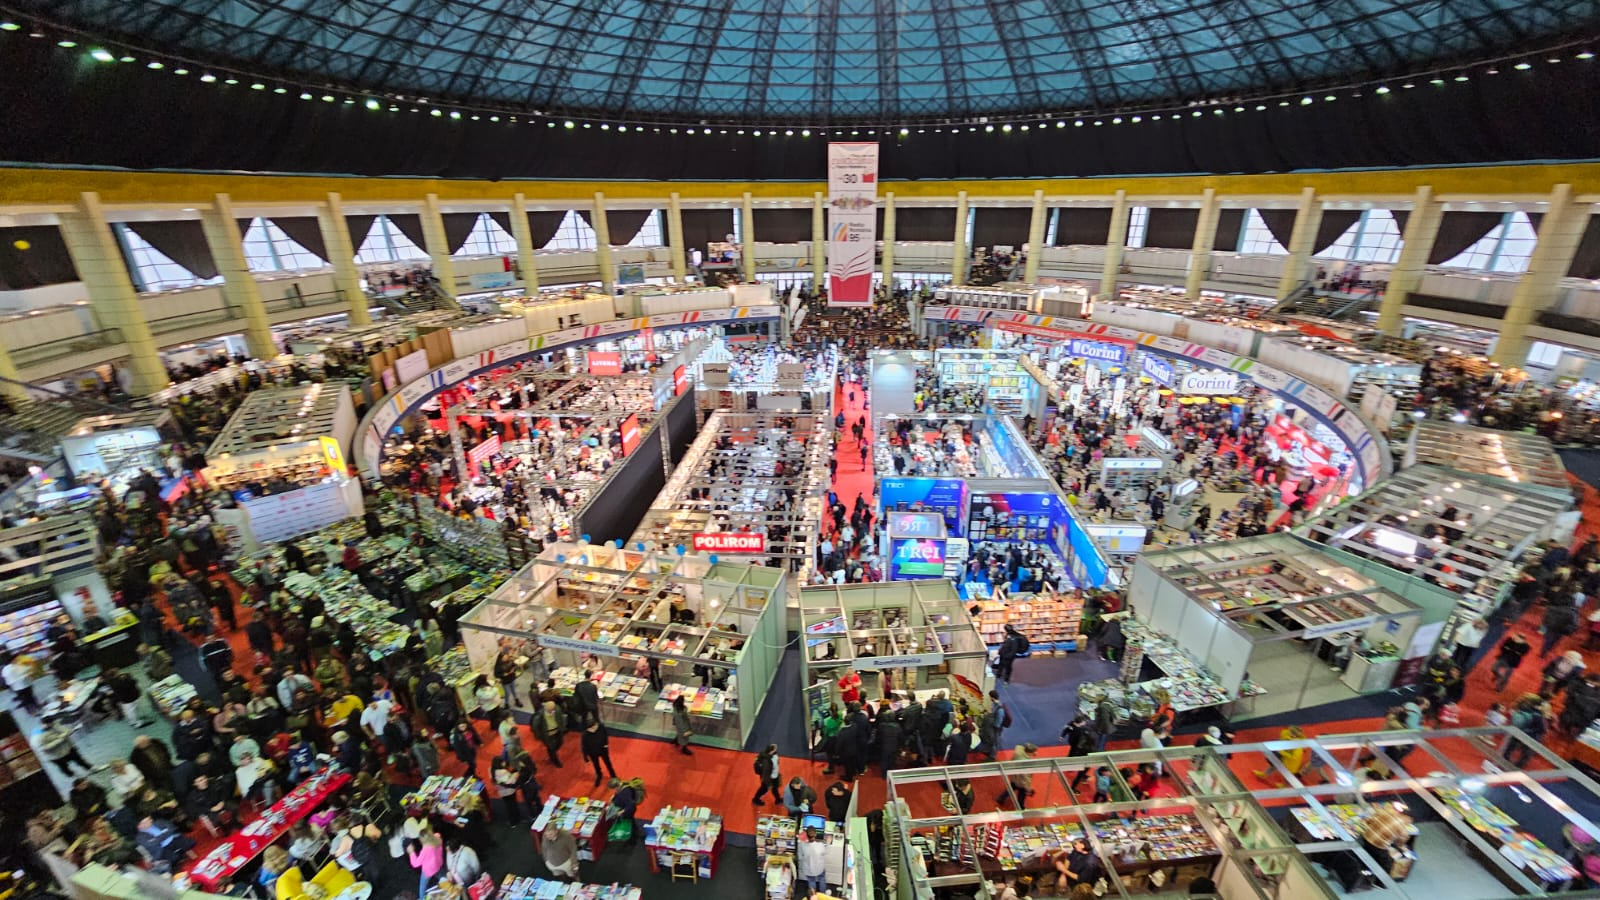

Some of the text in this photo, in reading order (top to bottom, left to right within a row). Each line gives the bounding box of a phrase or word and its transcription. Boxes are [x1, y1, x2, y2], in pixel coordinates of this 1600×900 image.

[1081, 343, 1122, 362] Corint
[1187, 377, 1232, 390] Corint
[695, 536, 761, 549] POLIROM
